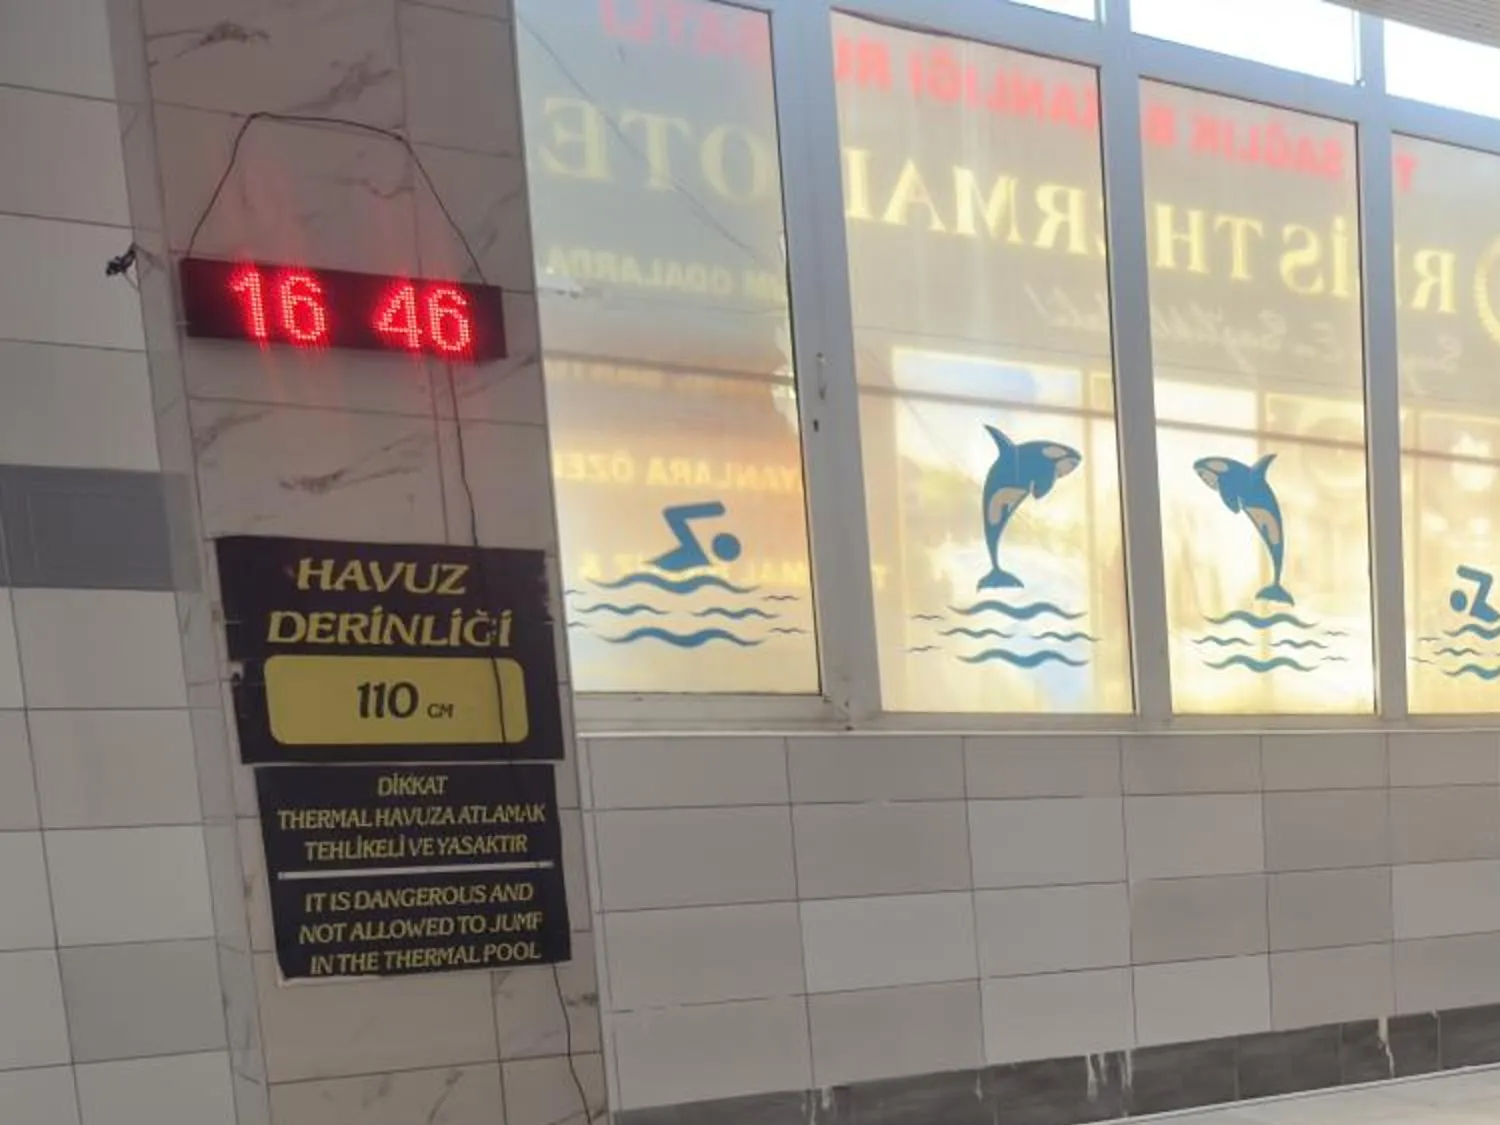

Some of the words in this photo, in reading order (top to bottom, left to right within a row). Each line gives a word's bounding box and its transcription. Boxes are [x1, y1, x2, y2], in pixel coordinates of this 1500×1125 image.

[230, 268, 327, 341] 16
[375, 283, 471, 352] 46
[297, 556, 470, 595] HAVUZ
[266, 604, 513, 648] DERİNLİĞİ
[356, 681, 420, 720] 110
[426, 703, 455, 719] CM
[376, 773, 448, 797] DİKKAT
[278, 808, 373, 830] THERMAL
[375, 806, 456, 828] HAVUZA
[457, 804, 546, 824] ATLAMAK
[304, 834, 406, 861] TEHLİKELİ
[408, 839, 436, 858] VE
[437, 834, 528, 857] YASAKTIR
[304, 892, 327, 913] IT
[329, 891, 351, 912] IS
[353, 884, 487, 911] DANGEROUS
[489, 883, 534, 903] AND
[299, 922, 347, 945] NOT
[349, 917, 455, 943] ALLOWED
[457, 914, 486, 935] TO
[310, 954, 335, 975] IN
[337, 952, 379, 974] THE
[383, 943, 481, 970] THERMAL
[482, 941, 542, 963] POOL
